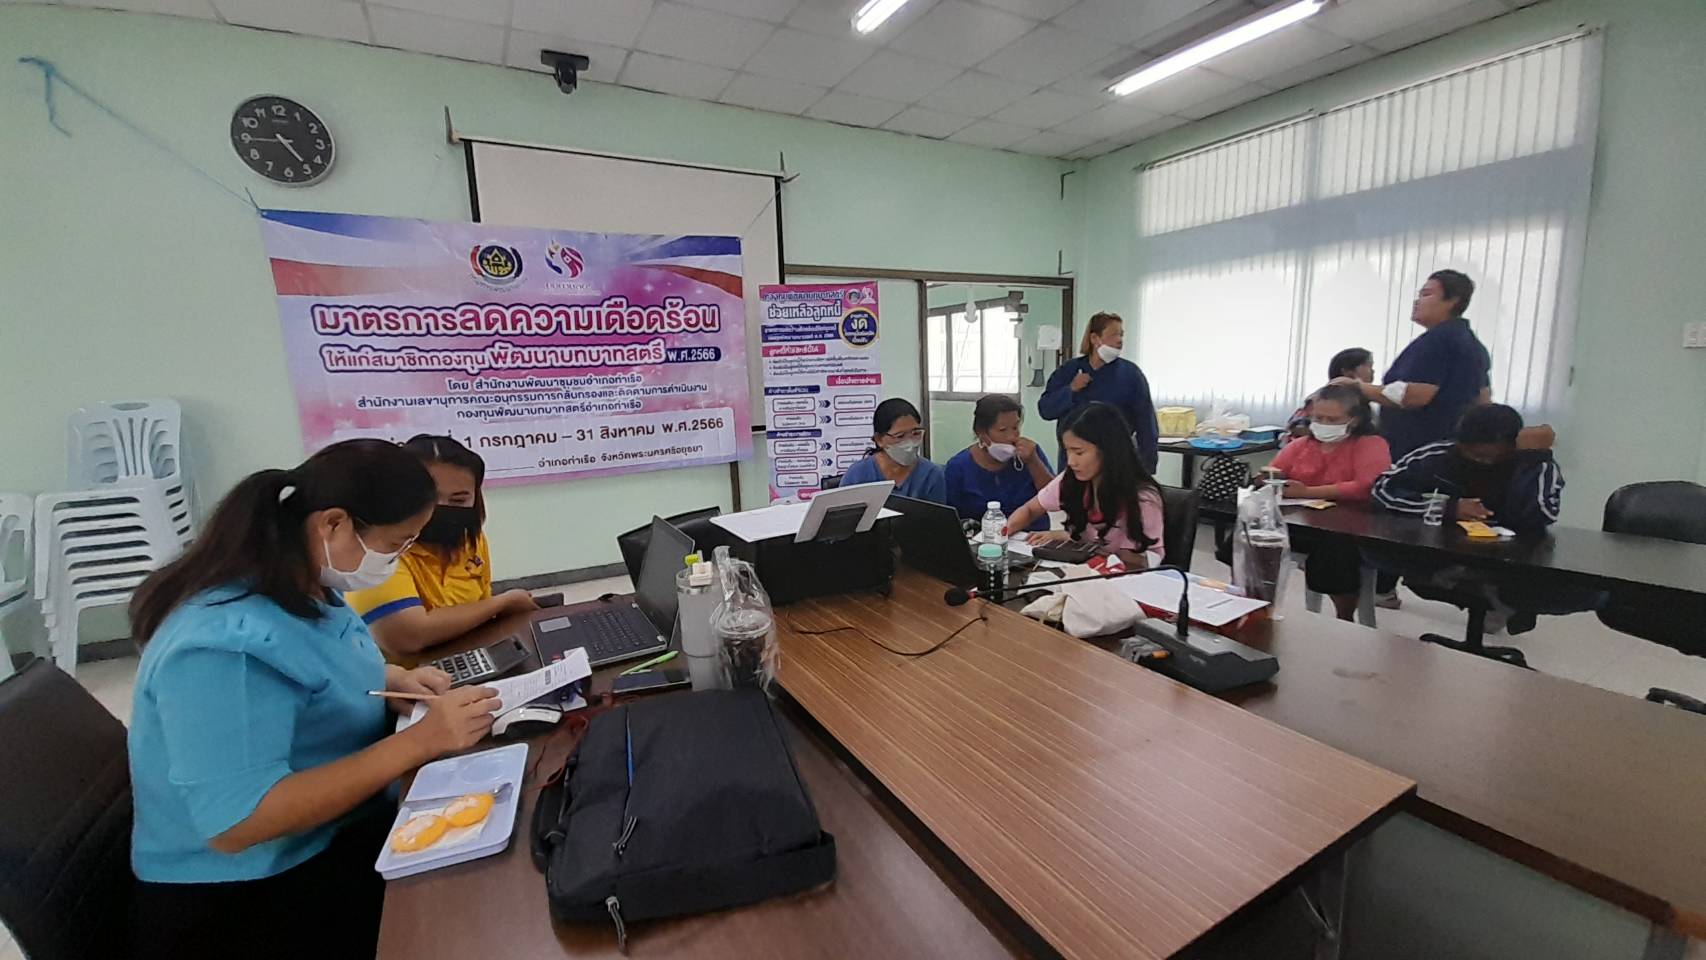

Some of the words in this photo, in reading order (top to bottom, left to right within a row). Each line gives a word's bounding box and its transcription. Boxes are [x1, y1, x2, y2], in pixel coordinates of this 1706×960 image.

[254, 108, 266, 118] 11
[272, 105, 286, 116] 12
[294, 112, 300, 121] 1
[241, 117, 258, 128] 10
[308, 122, 318, 134] 2
[241, 133, 250, 144] 9
[315, 139, 325, 150] 3
[250, 148, 260, 160] 8
[314, 155, 322, 164] 4
[266, 161, 273, 171] 7
[302, 164, 312, 174] 5
[284, 167, 294, 178] 6
[318, 300, 718, 333] มาตรการลดความเดือดร้อน
[850, 318, 868, 331] งด
[326, 349, 486, 370] ให้แก่สมาชิกกองทุน
[490, 342, 664, 365] พัฒนาบทบาทสตรี
[666, 347, 716, 362] พ.ศ.2566
[448, 379, 469, 391] โดย
[456, 399, 642, 421] กองทุนพัฒนาบทบาทสตรีอำเภอท่าเรือ
[463, 436, 473, 449] 1
[479, 431, 557, 449] กรกฎาคม
[576, 429, 594, 442] 31
[599, 423, 656, 440] สิงหาคม
[661, 416, 725, 434] พ.ศ.2566
[538, 454, 597, 469] อำเภอท่าเรือ
